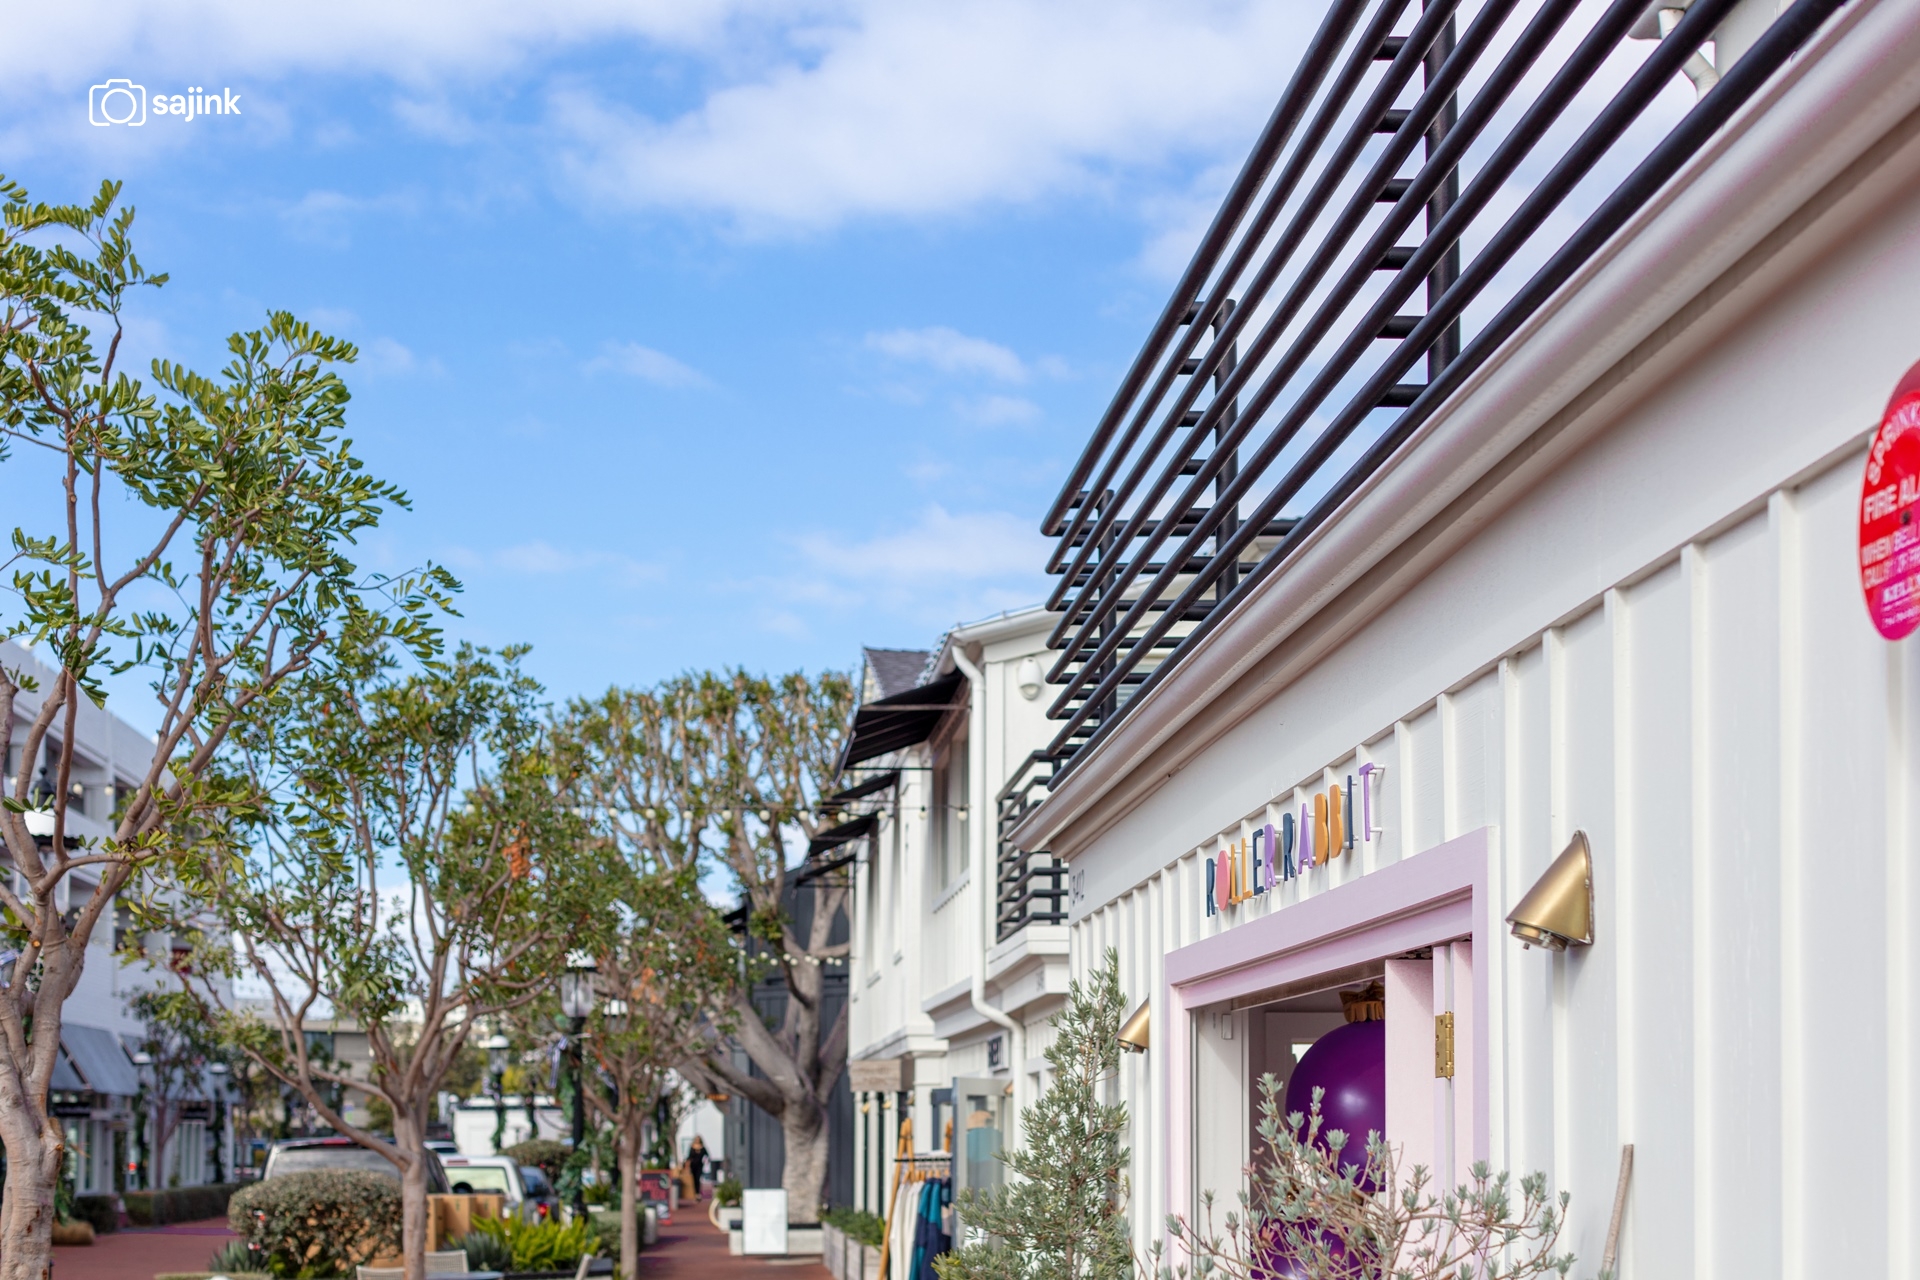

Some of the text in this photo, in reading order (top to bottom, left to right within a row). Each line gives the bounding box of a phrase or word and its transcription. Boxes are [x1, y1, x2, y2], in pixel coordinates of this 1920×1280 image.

[1863, 482, 1898, 525] FIRE
[1206, 762, 1374, 917] ROLLER RABBIT
